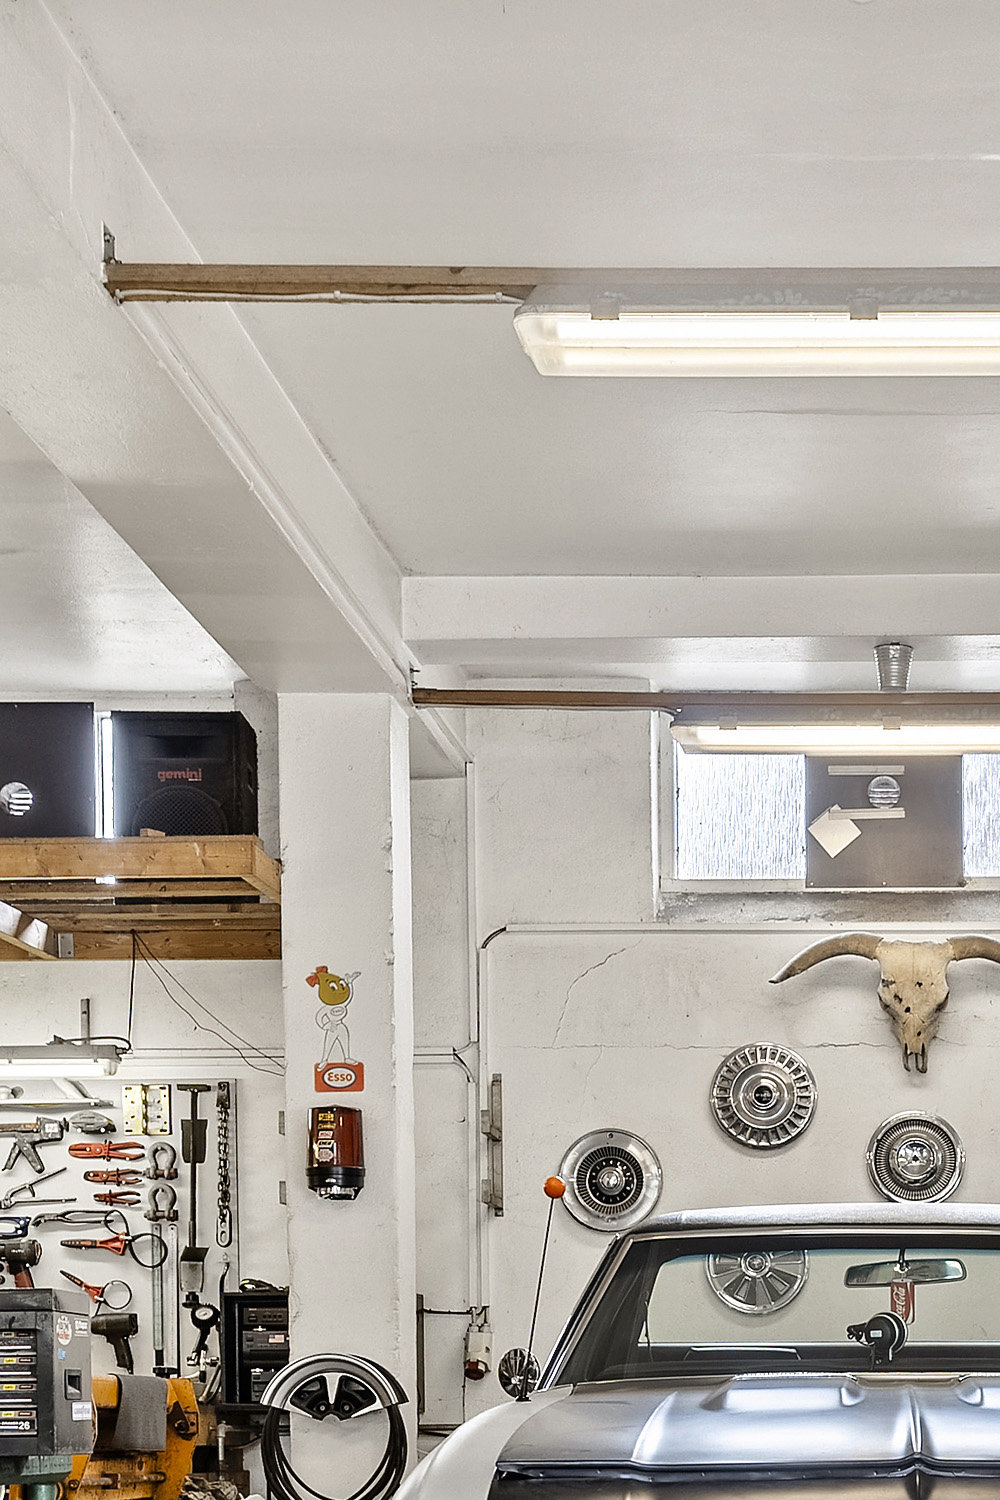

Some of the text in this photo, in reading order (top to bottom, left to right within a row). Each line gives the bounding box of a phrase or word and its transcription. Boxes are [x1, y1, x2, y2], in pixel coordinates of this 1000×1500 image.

[157, 768, 202, 782] gemini
[327, 1071, 353, 1082] Esso
[18, 1420, 31, 1430] 26
